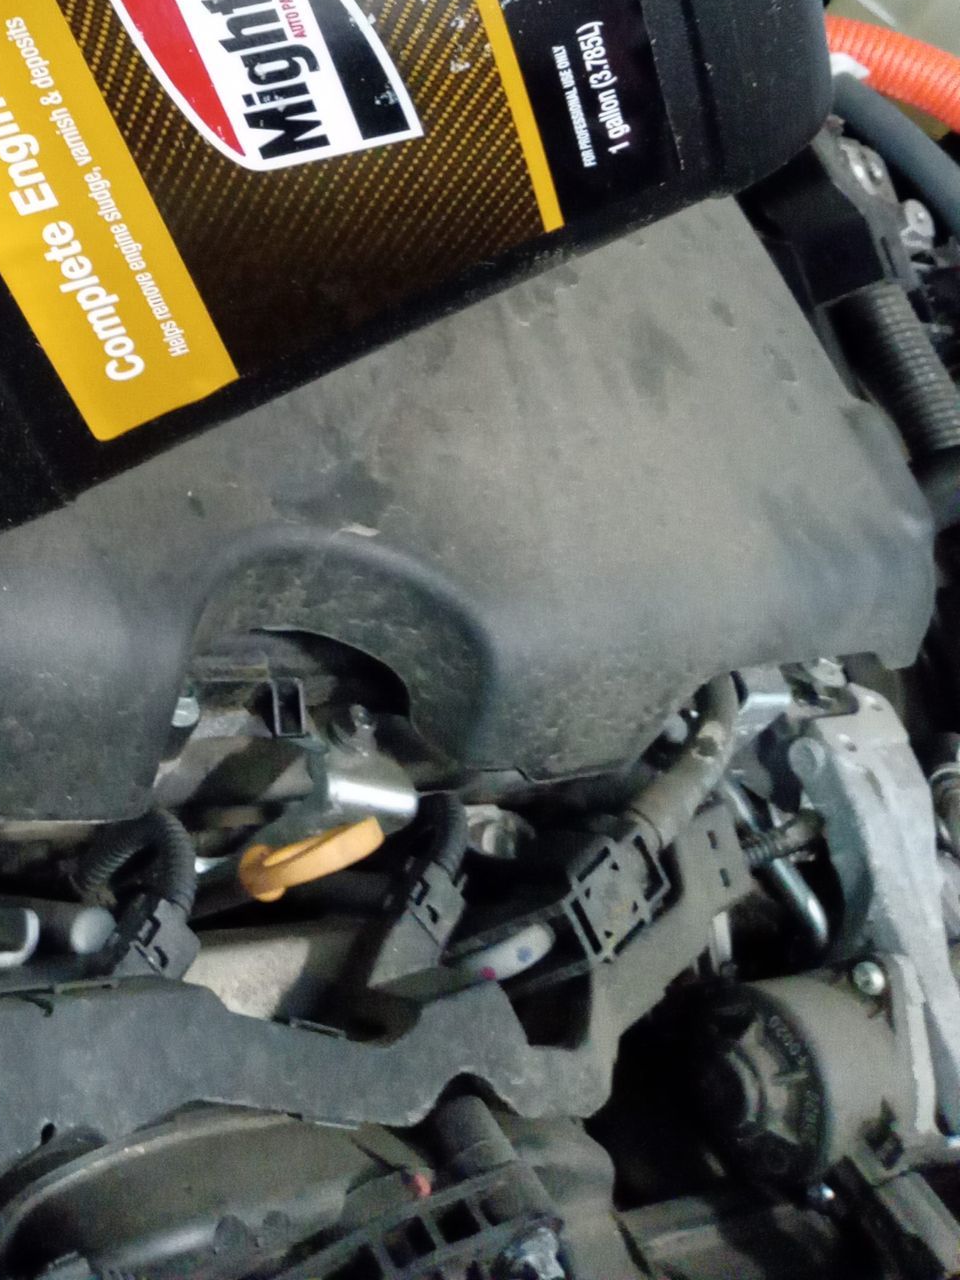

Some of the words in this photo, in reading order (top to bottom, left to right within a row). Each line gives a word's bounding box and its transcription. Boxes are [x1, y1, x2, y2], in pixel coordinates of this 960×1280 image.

[285, 11, 307, 38] AUTO
[5, 16, 54, 89] deposits
[552, 45, 570, 70] ONLY
[576, 21, 618, 89] (3.785L)
[39, 89, 63, 106] &
[558, 68, 576, 88] USE
[49, 107, 92, 166] varnish
[565, 86, 592, 150] PROFESSIONAL
[598, 89, 631, 140] gallon
[581, 148, 597, 168] FOR
[608, 141, 630, 154] 1
[84, 166, 123, 222] sludge,
[110, 223, 147, 271] engine
[42, 220, 145, 382] Complete
[135, 271, 172, 321] remove
[160, 320, 189, 357] Helps
